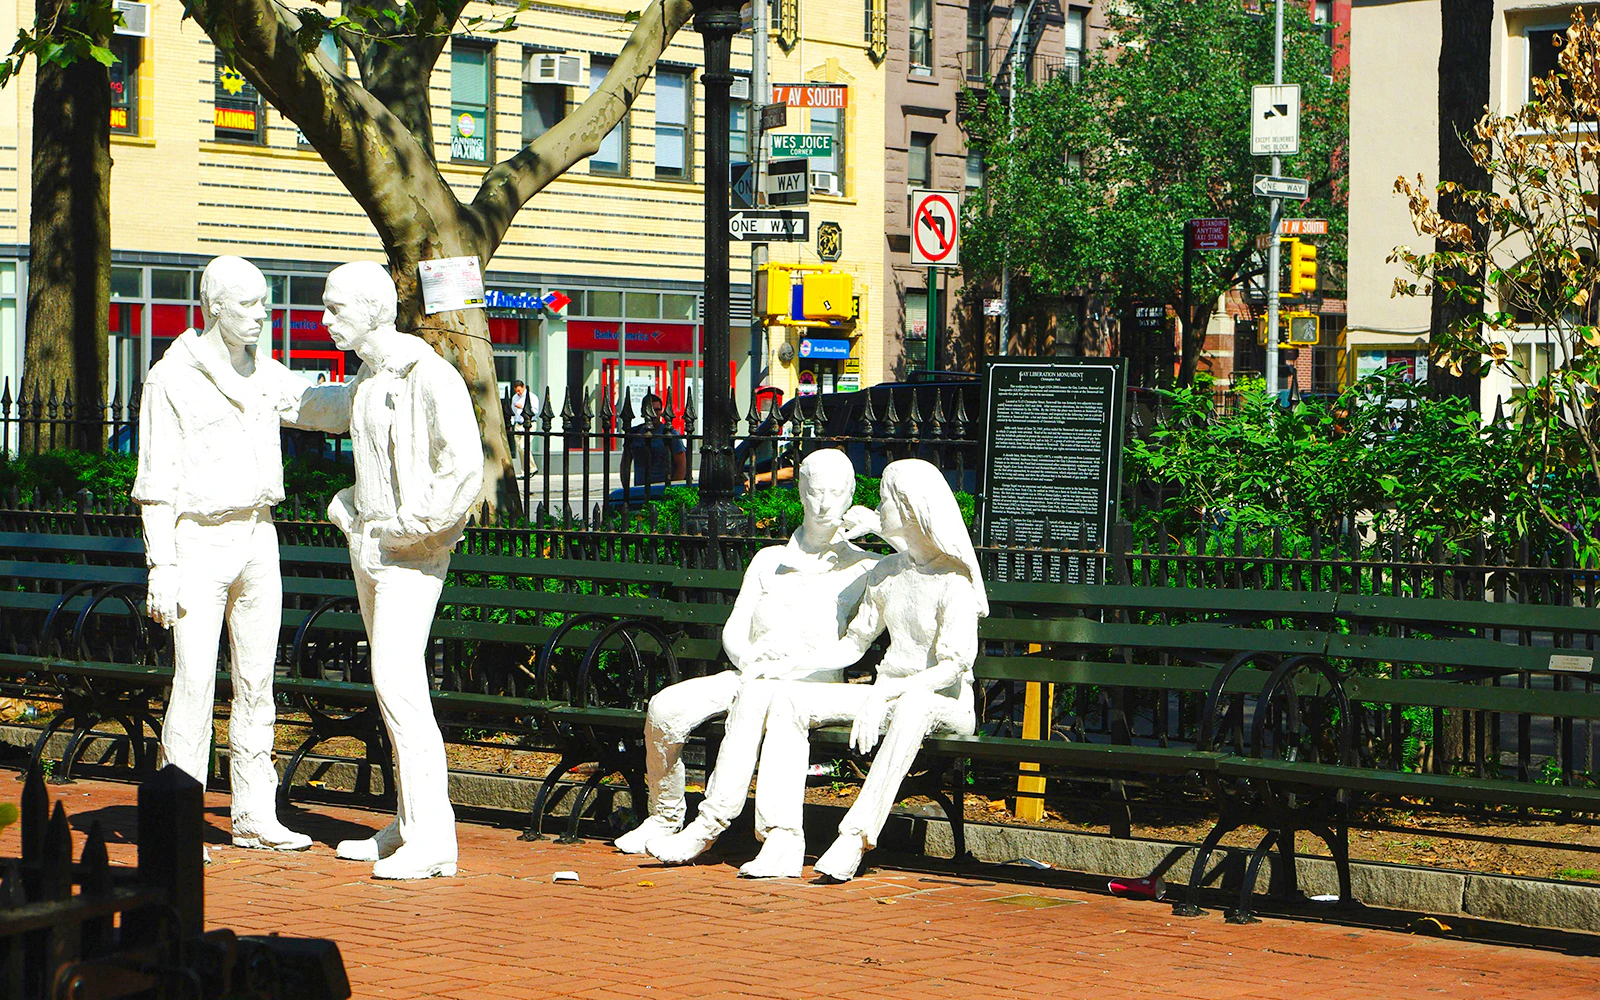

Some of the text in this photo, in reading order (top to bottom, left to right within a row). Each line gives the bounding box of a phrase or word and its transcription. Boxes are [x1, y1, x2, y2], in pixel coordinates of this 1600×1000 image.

[775, 88, 843, 107] 7 AV SOUTH
[214, 110, 255, 131] TANNING
[773, 135, 830, 149] WES JOICE
[1272, 135, 1295, 143] DELIVERIES
[789, 148, 813, 156] CORNER
[738, 174, 801, 195] ON WAY
[1261, 181, 1304, 193] ONE WAY
[731, 219, 798, 233] ONE WAY
[1201, 220, 1227, 228] STANDING
[1283, 221, 1325, 233] 7 AV SOUTH
[1194, 233, 1224, 241] TAXI STAND
[495, 290, 543, 309] America
[289, 319, 318, 331] merica
[594, 328, 612, 341] Bank
[1056, 371, 1084, 379] MONUMENT
